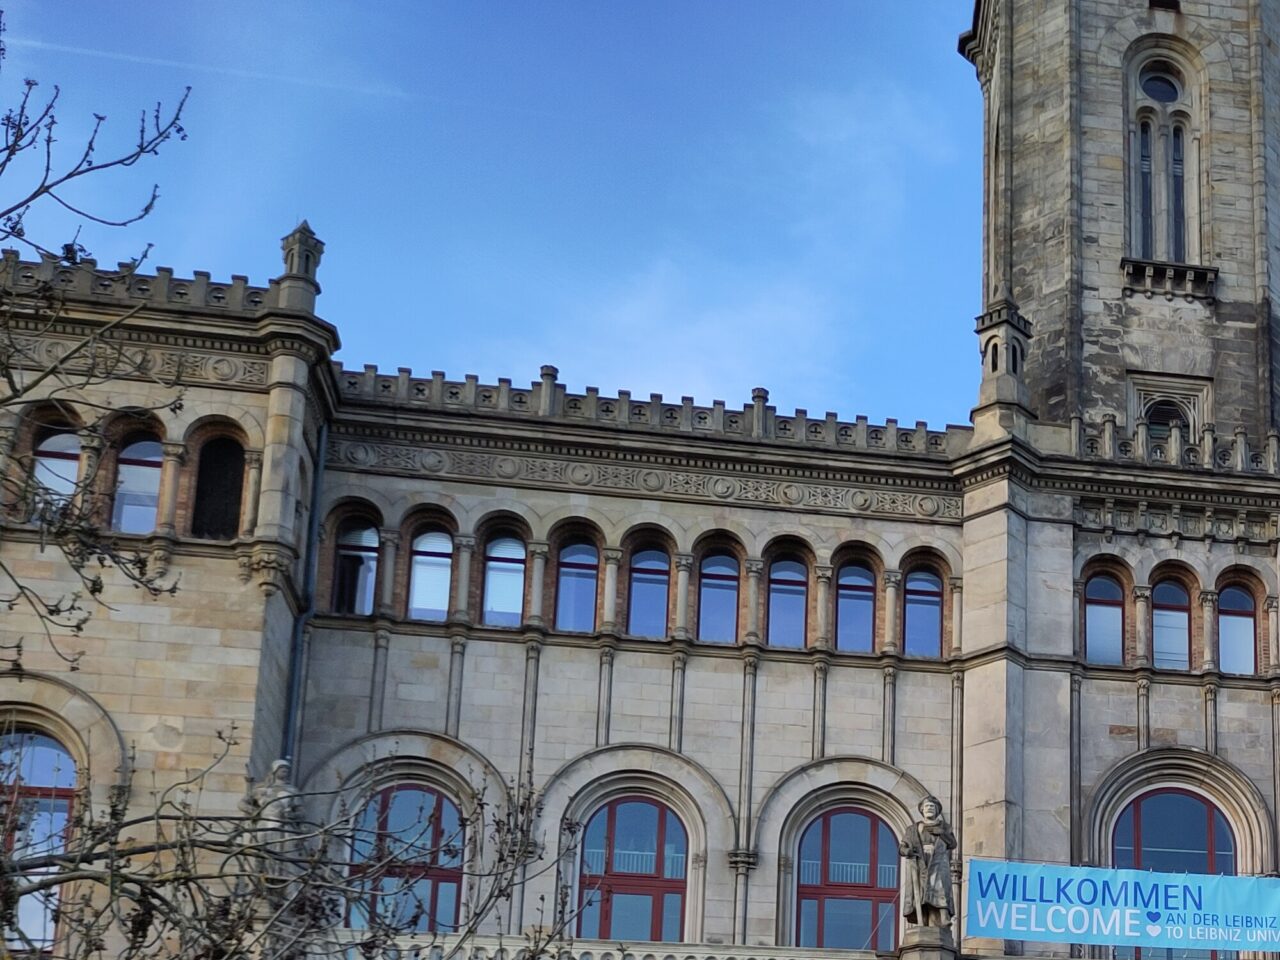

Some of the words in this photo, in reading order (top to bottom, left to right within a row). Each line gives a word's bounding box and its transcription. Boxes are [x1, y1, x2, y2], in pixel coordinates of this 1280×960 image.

[977, 871, 1203, 911] WILLKOMMEN
[976, 900, 1141, 937] WELCOME
[1165, 912, 1187, 925] AN
[1193, 913, 1219, 927] DER
[1225, 914, 1277, 929] LEIBNIZ
[1165, 926, 1184, 939] TO
[1189, 927, 1241, 941] LEIBNIZ
